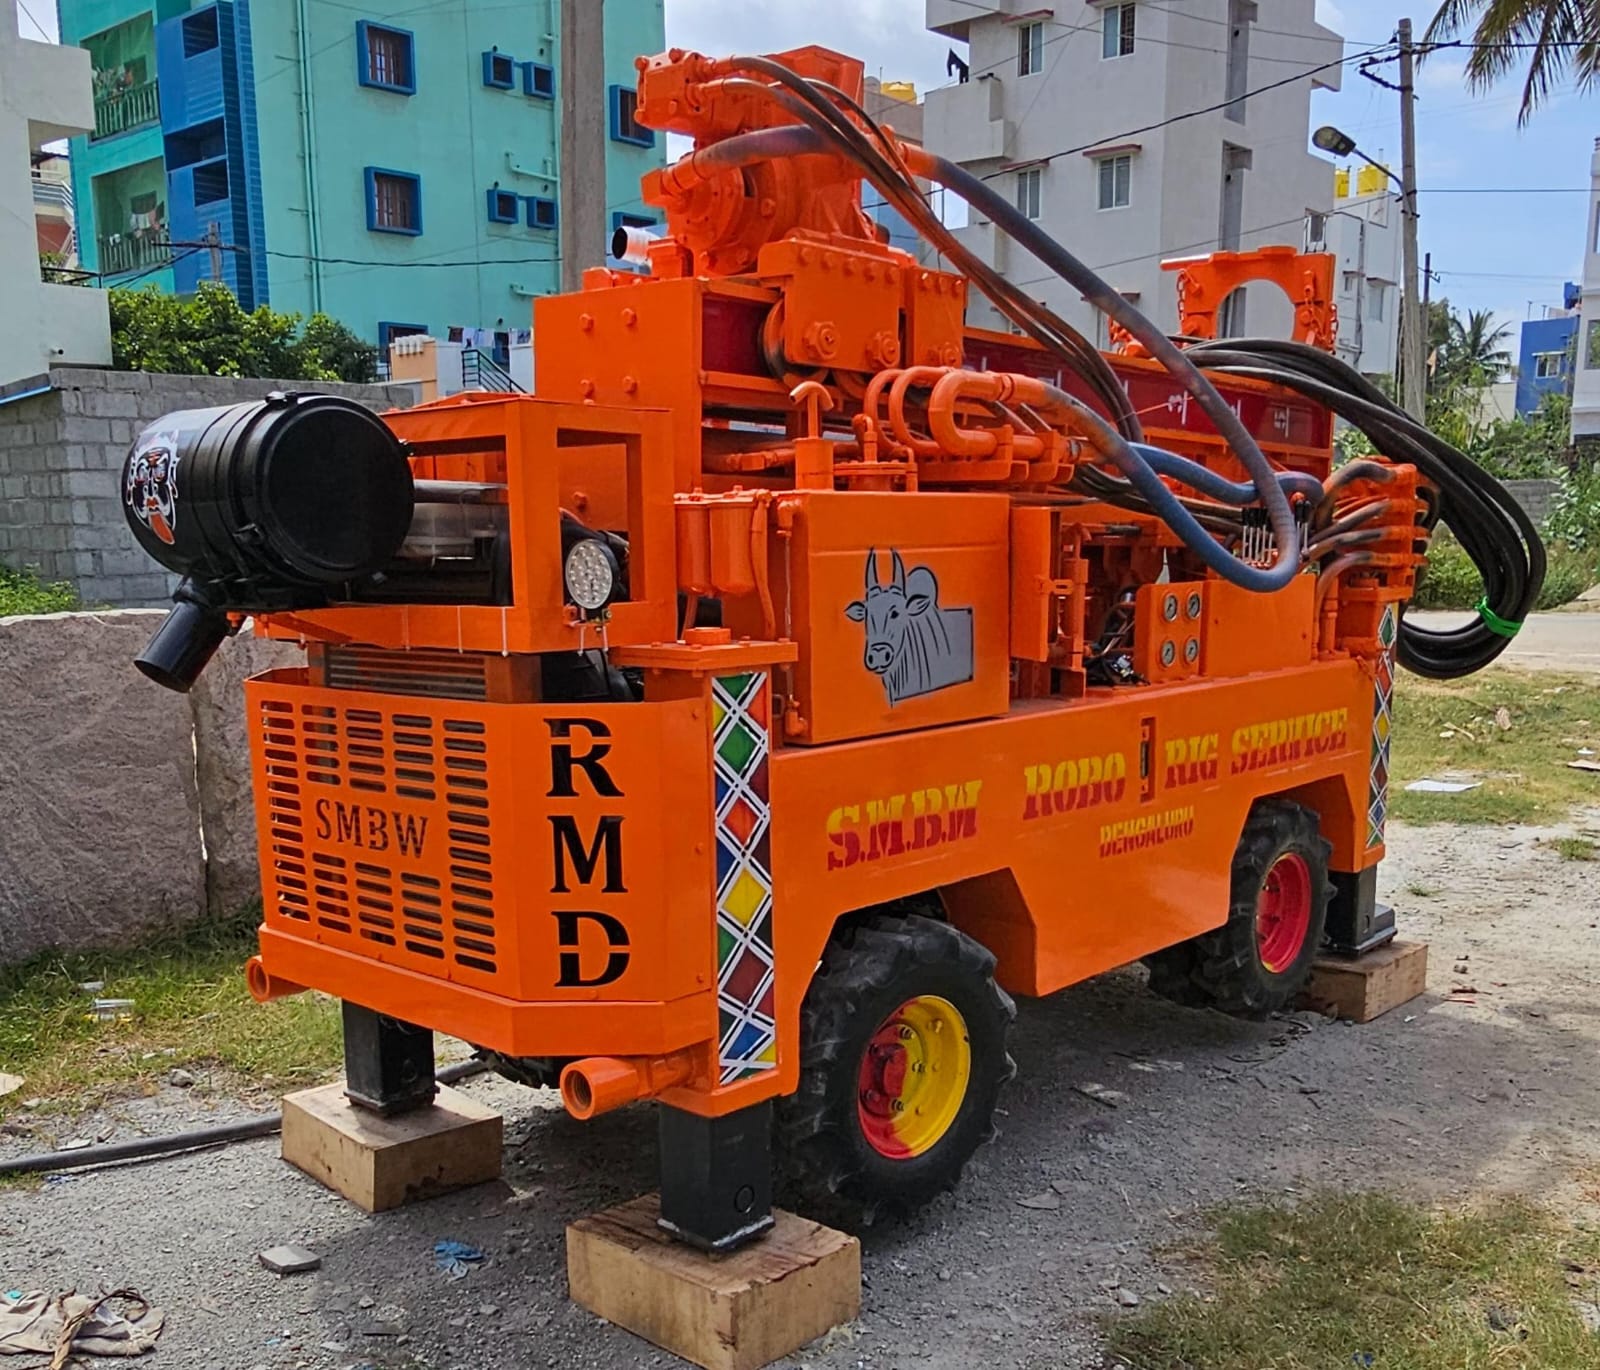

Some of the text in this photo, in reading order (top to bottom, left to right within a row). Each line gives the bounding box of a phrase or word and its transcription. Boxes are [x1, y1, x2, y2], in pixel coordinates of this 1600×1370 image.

[316, 798, 428, 858] SMBW
[826, 707, 1348, 872] S.M.B.W ROBO RIG SERVICE
[1099, 805, 1194, 858] BENGALURU
[543, 718, 631, 988] RMD
